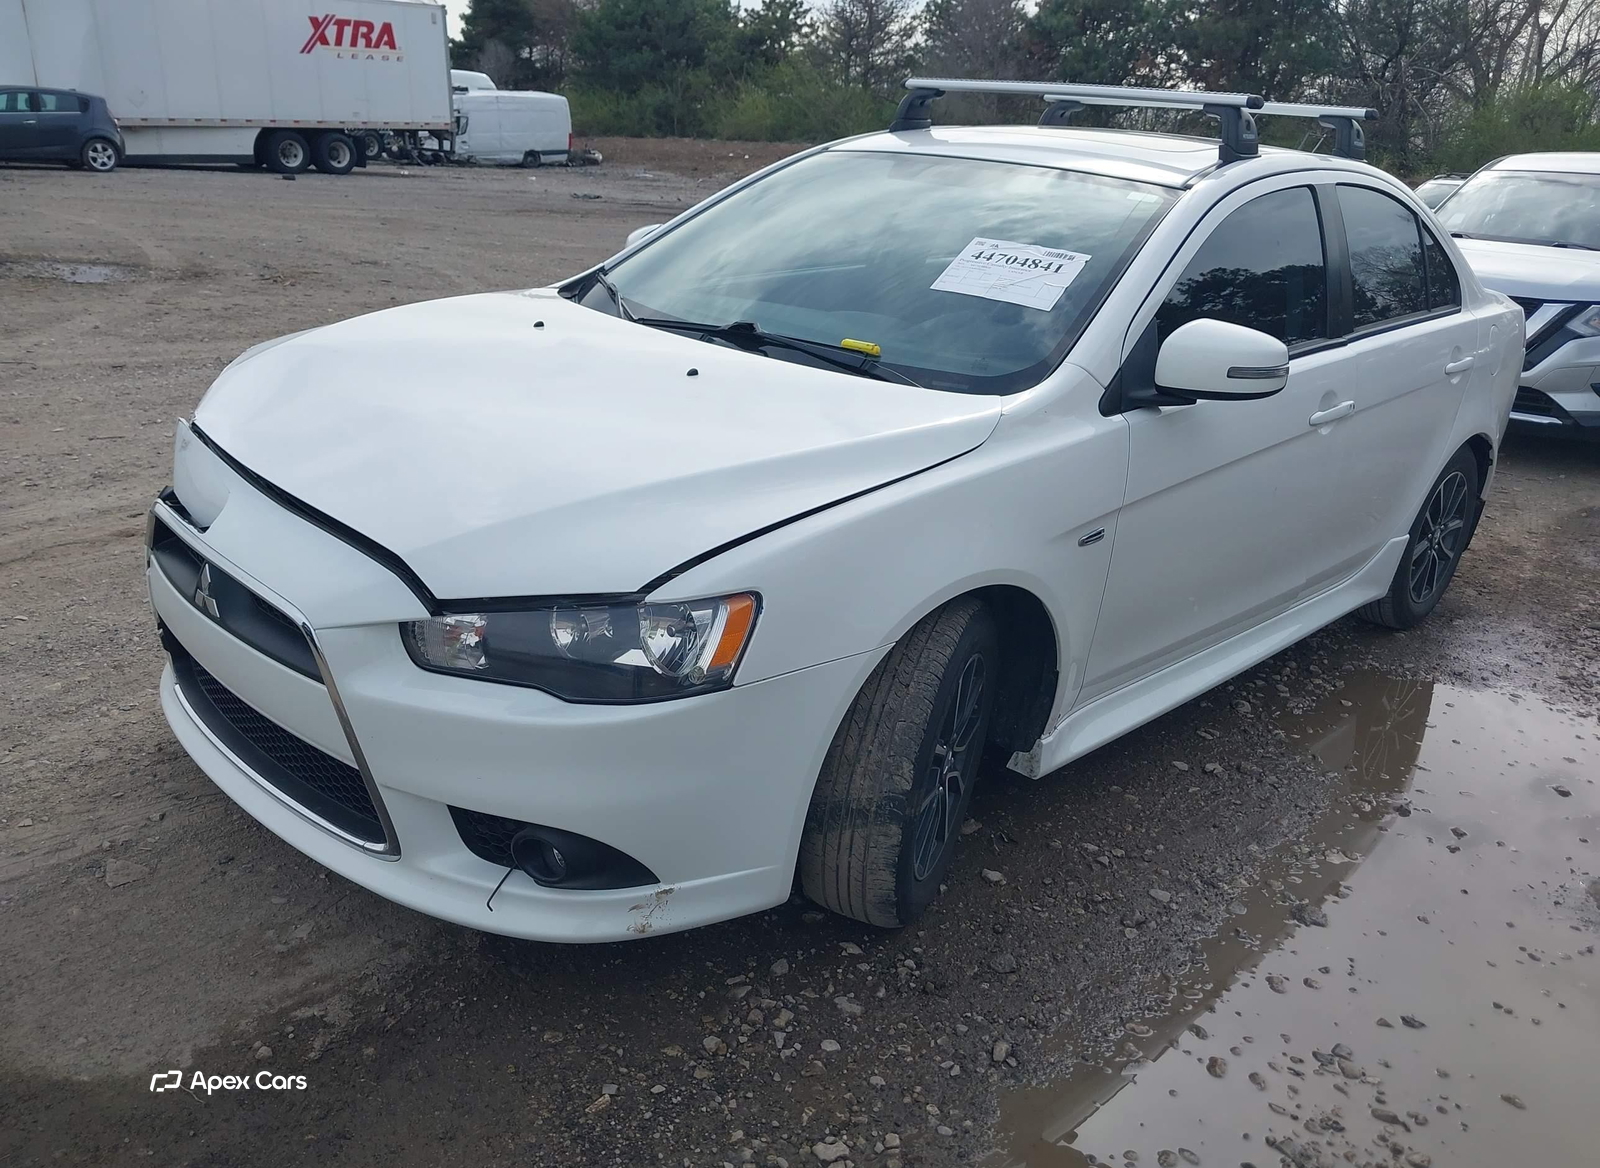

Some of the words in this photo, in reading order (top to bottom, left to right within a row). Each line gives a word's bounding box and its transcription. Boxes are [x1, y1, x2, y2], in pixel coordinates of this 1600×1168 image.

[299, 14, 397, 54] XTRA
[336, 52, 404, 62] LEASE
[971, 250, 1064, 273] 44704841
